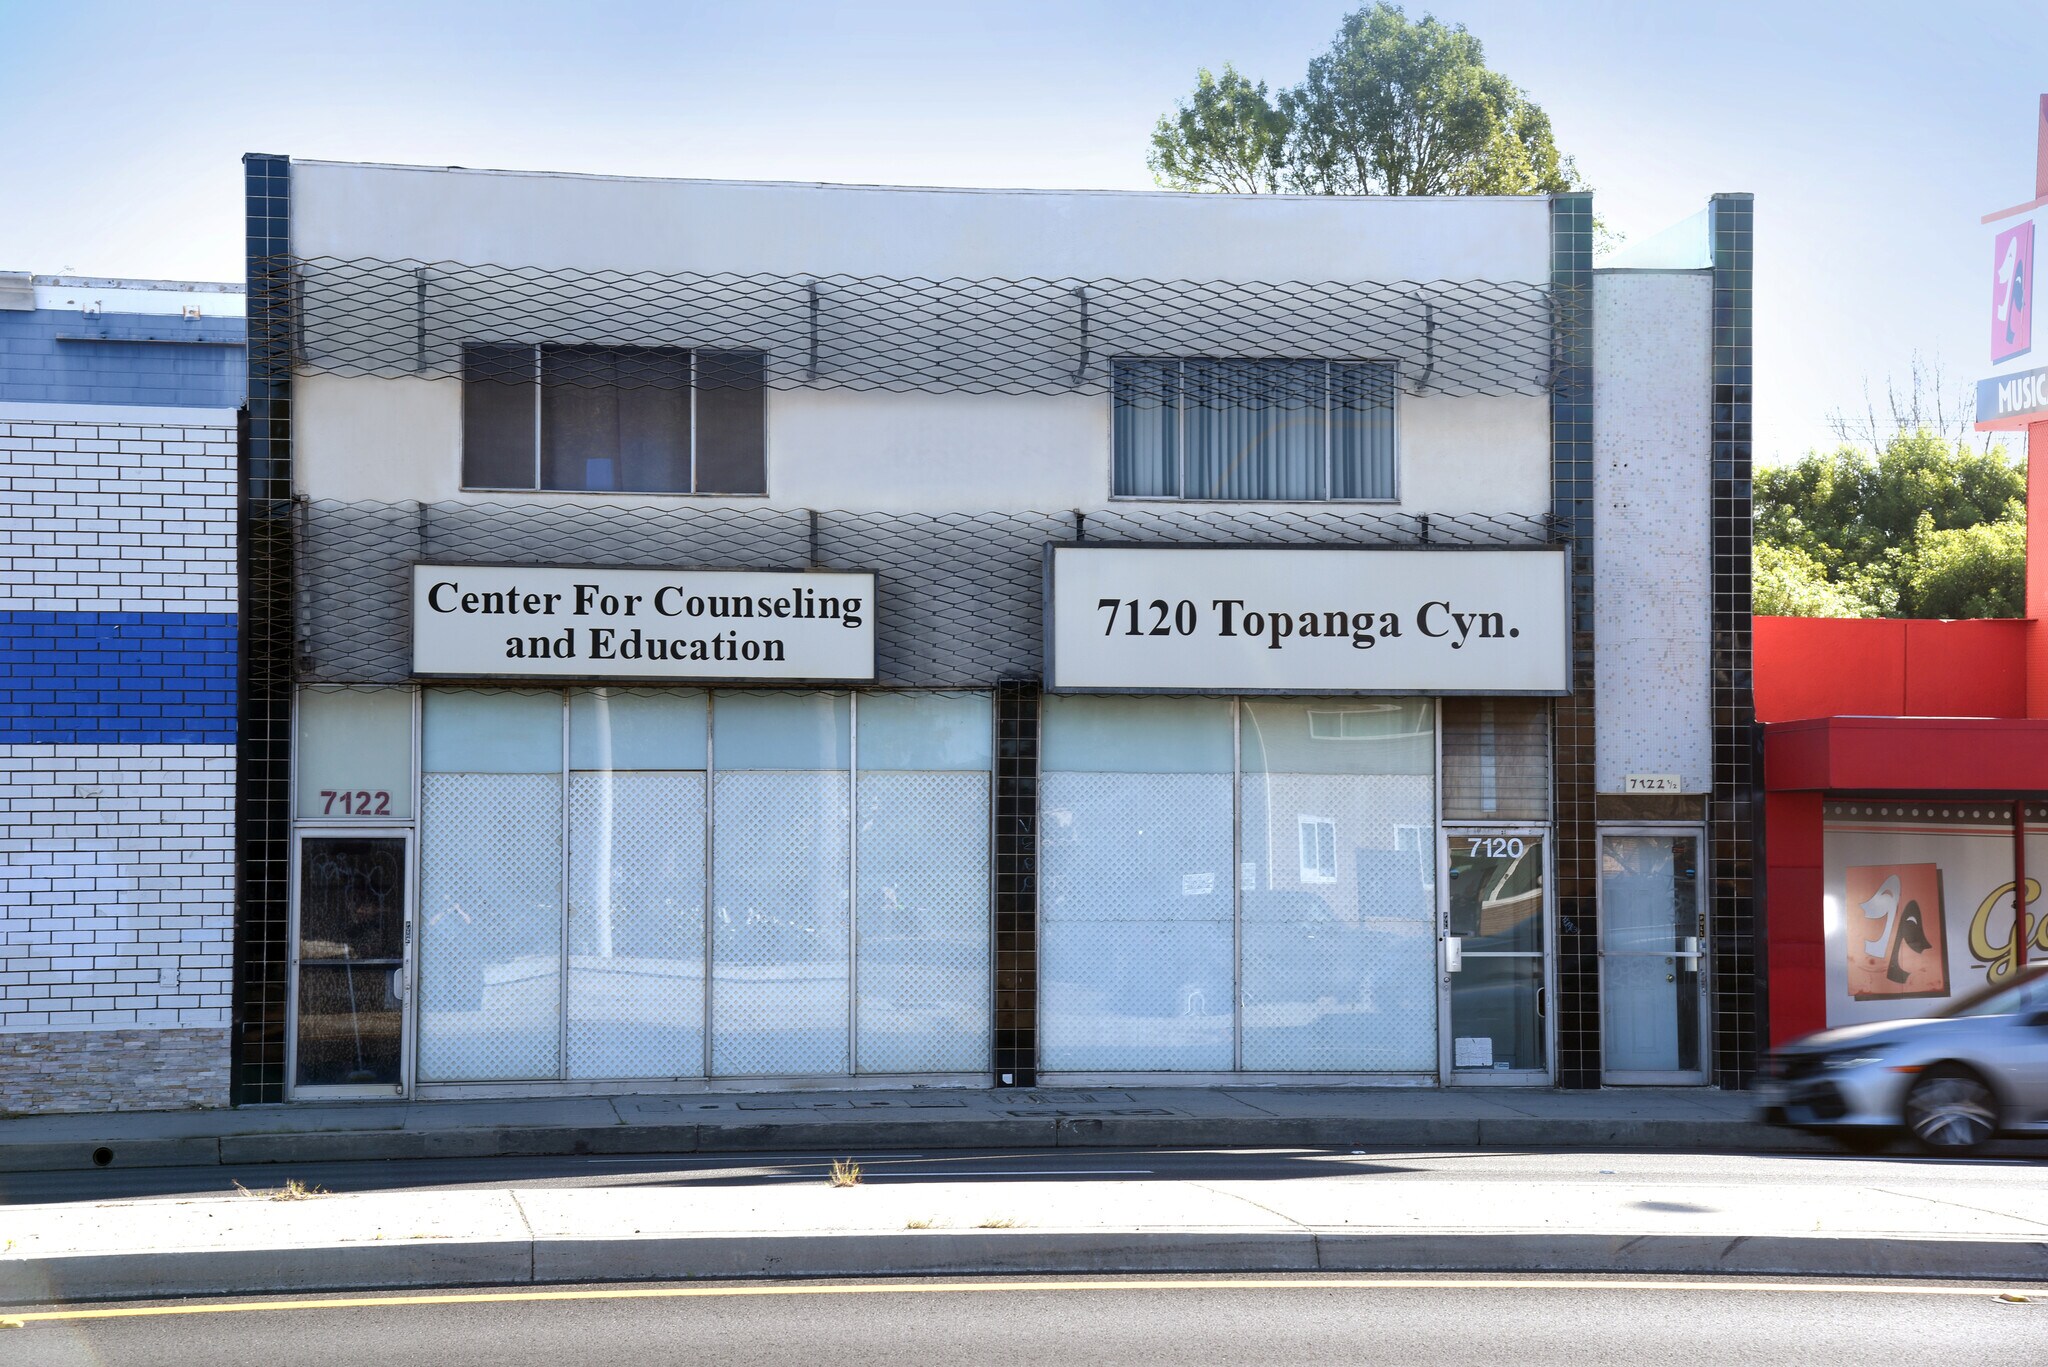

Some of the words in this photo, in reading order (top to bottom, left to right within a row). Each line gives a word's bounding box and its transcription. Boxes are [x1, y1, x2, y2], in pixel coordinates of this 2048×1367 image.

[428, 583, 561, 614] Center
[573, 585, 642, 616] For
[655, 587, 862, 628] Counseling
[1098, 599, 1196, 635] 7120
[1213, 600, 1402, 649] Topanga
[1417, 602, 1519, 649] Cyn.
[506, 628, 575, 658] and
[589, 629, 785, 660] Education
[1630, 779, 1665, 789] 7122
[320, 790, 391, 815] 7122
[1467, 837, 1524, 858] 7120
